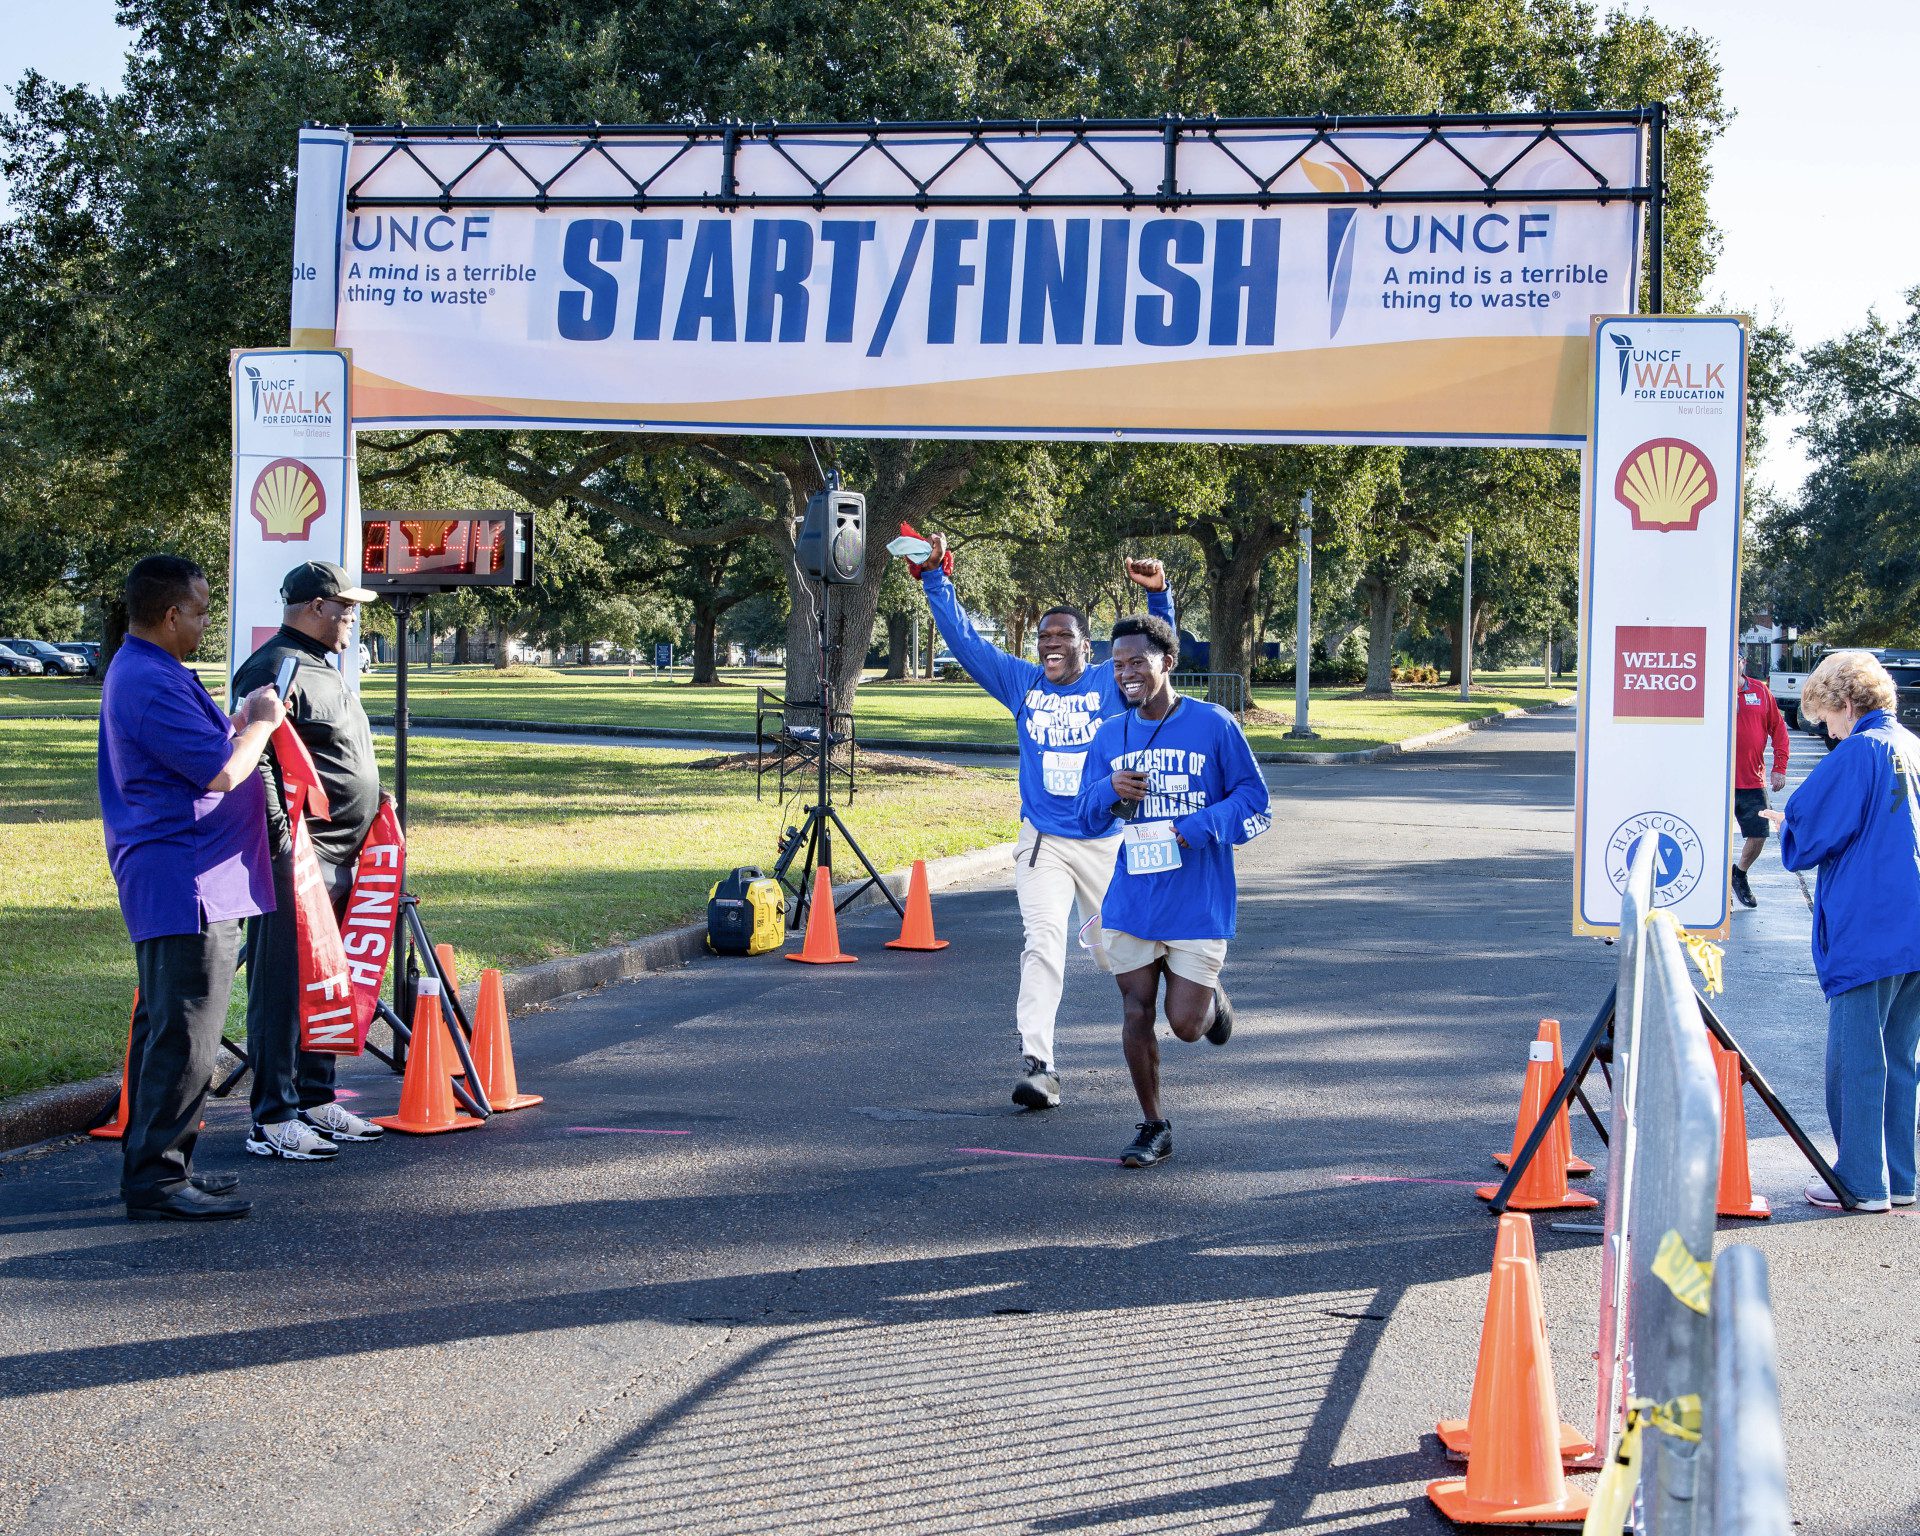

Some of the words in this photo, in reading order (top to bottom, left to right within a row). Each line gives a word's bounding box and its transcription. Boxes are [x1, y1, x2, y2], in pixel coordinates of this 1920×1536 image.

[352, 215, 490, 252] UNCF
[1385, 213, 1550, 254] UNCF
[348, 262, 362, 279] A
[368, 263, 418, 281] mind
[425, 264, 439, 282] is
[446, 268, 457, 281] a
[463, 264, 537, 282] terrible
[1383, 266, 1400, 285] A
[1408, 265, 1465, 285] mind
[1473, 265, 1492, 284] is
[1499, 269, 1513, 284] a
[1521, 264, 1609, 284] terrible
[347, 284, 396, 305] thing
[403, 285, 423, 302] to
[557, 217, 1281, 358] START/FINISH
[1382, 290, 1441, 313] thing
[1450, 291, 1473, 308] to
[1633, 350, 1681, 362] UNCF
[261, 379, 295, 391] UNCF
[1634, 363, 1726, 389] WALK
[263, 391, 332, 415] WALK
[1634, 390, 1656, 399] FOR
[1660, 390, 1725, 399] EDUCATION
[263, 415, 278, 424] FOR
[281, 415, 332, 424] EDUCATION
[1678, 405, 1694, 415] New
[1695, 405, 1723, 415] Orleans
[305, 428, 331, 438] Orleans
[1622, 652, 1697, 669] WELLS
[1623, 673, 1697, 691] FARGO
[1189, 751, 1206, 777] OF
[1045, 770, 1081, 791] 133
[1612, 816, 1697, 853] HANCOCK
[1130, 841, 1173, 868] 1337
[1612, 866, 1696, 904] WNEY
[343, 844, 399, 987] FINISH
